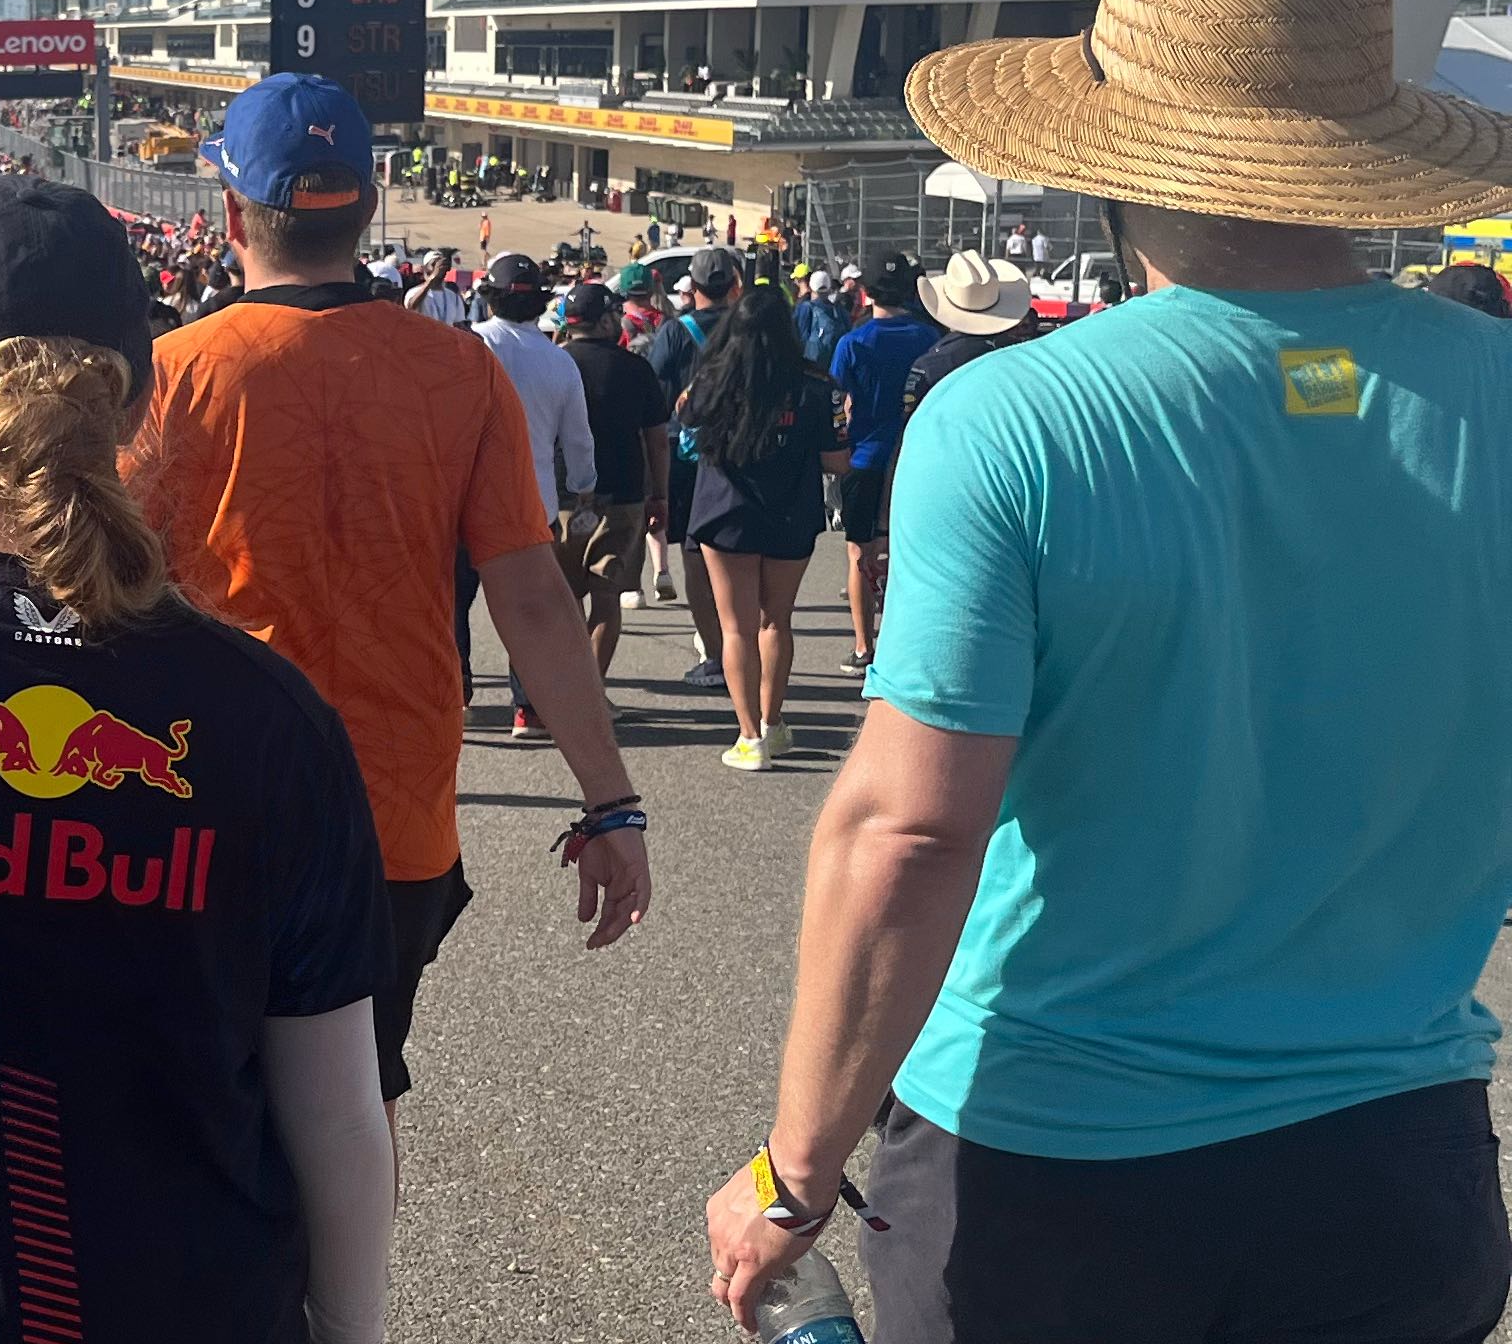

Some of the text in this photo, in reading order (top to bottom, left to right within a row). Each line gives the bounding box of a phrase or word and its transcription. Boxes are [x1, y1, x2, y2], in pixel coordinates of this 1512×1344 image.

[296, 24, 402, 57] 9 STR
[14, 630, 82, 647] CASTORE
[45, 817, 216, 912] Bull
